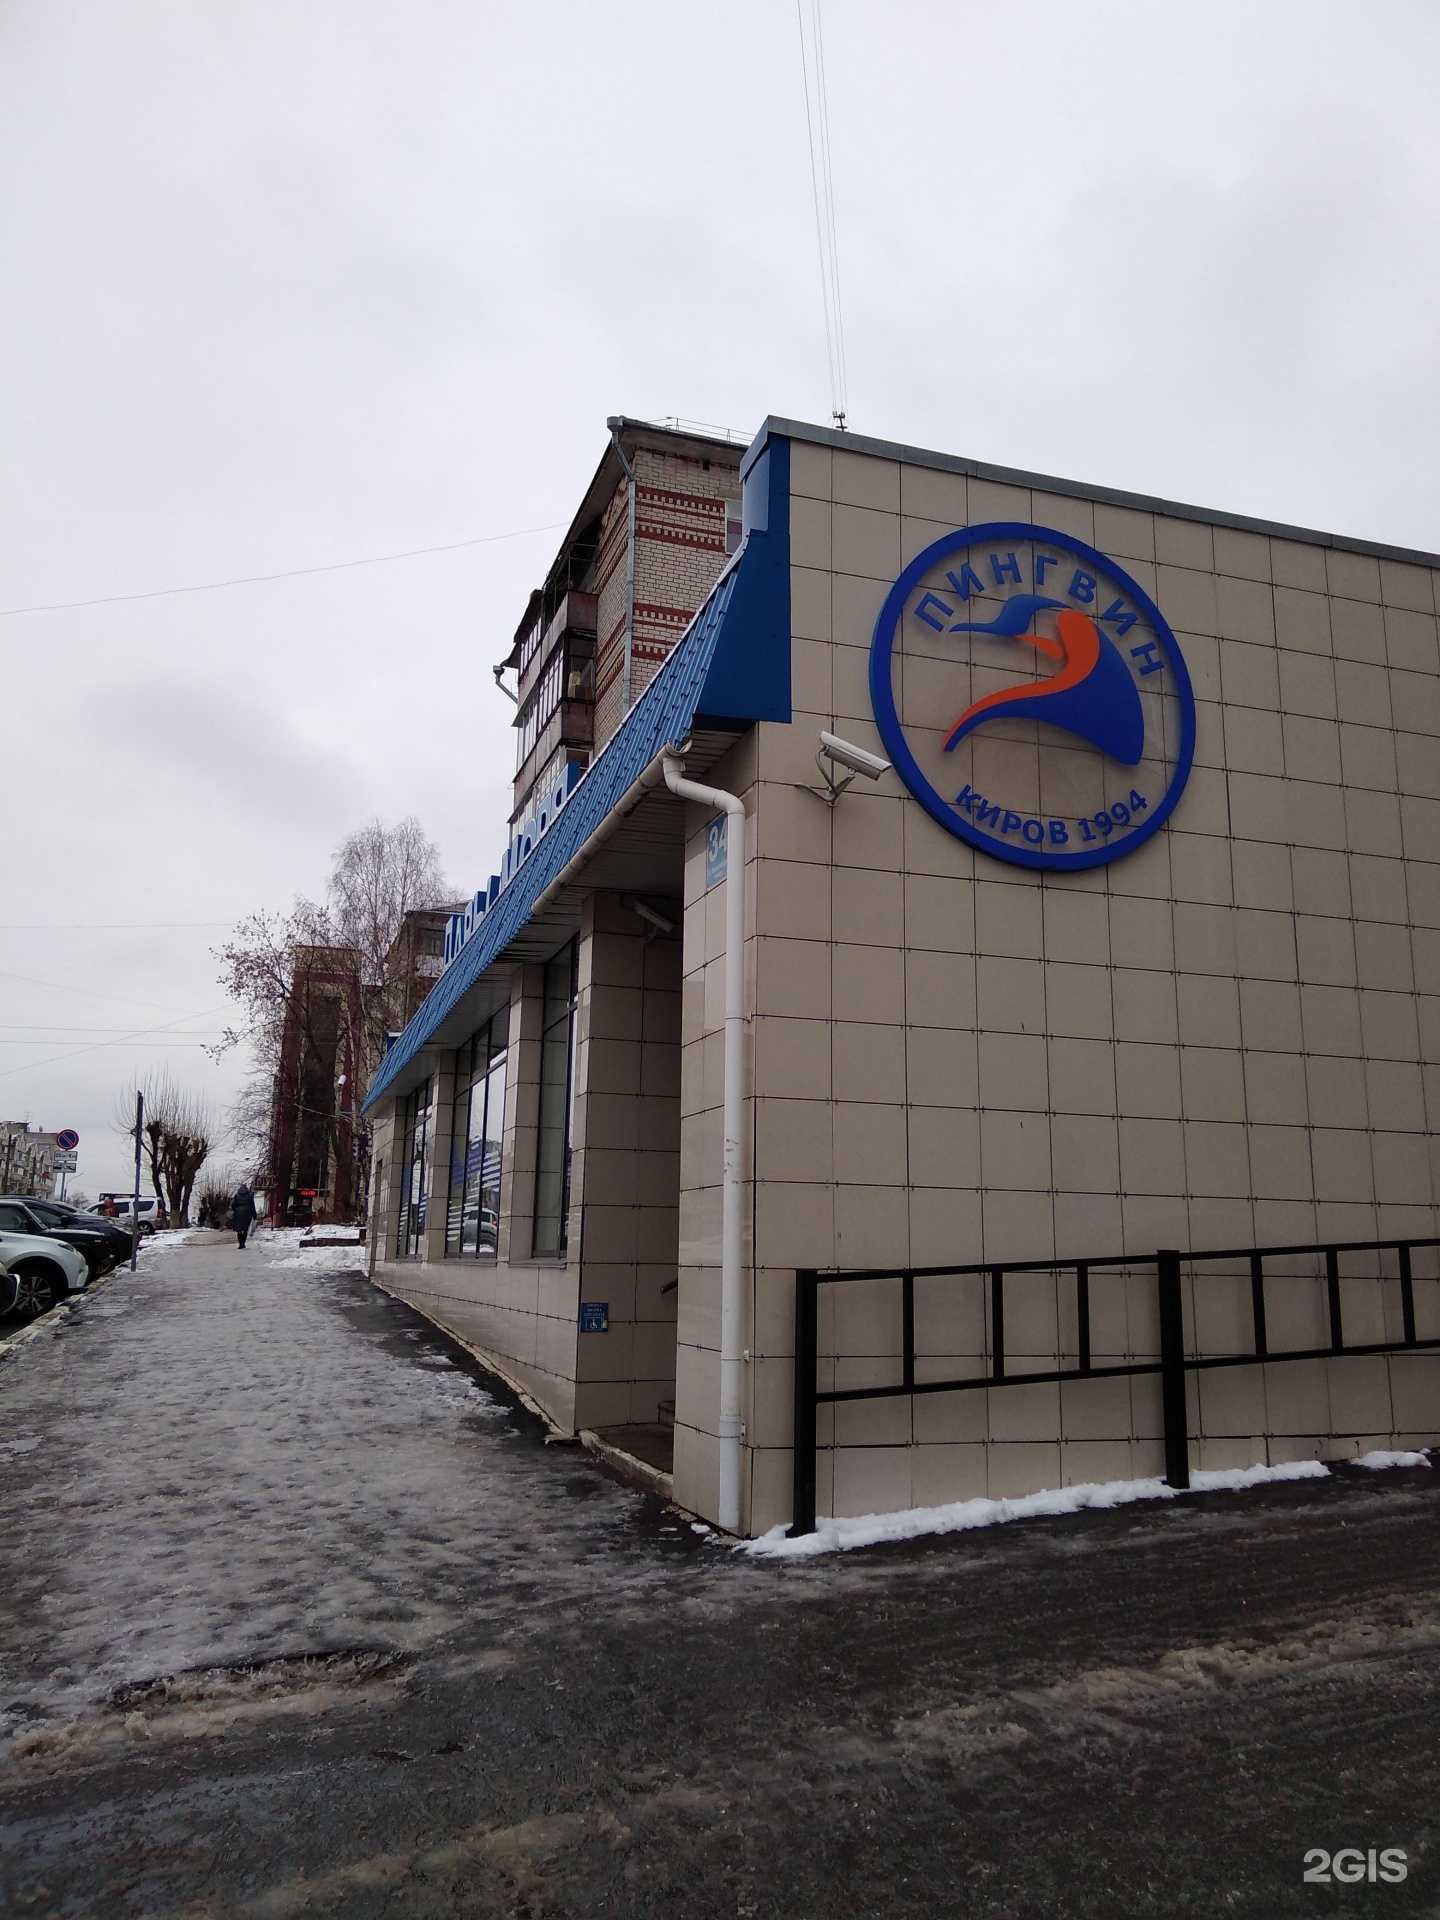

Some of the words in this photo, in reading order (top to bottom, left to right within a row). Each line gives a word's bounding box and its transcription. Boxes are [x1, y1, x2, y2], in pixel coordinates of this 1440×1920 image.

[914, 552, 1164, 677] ПИНГВИН
[954, 784, 1069, 845] КИРОВ
[1078, 789, 1148, 842] 1994
